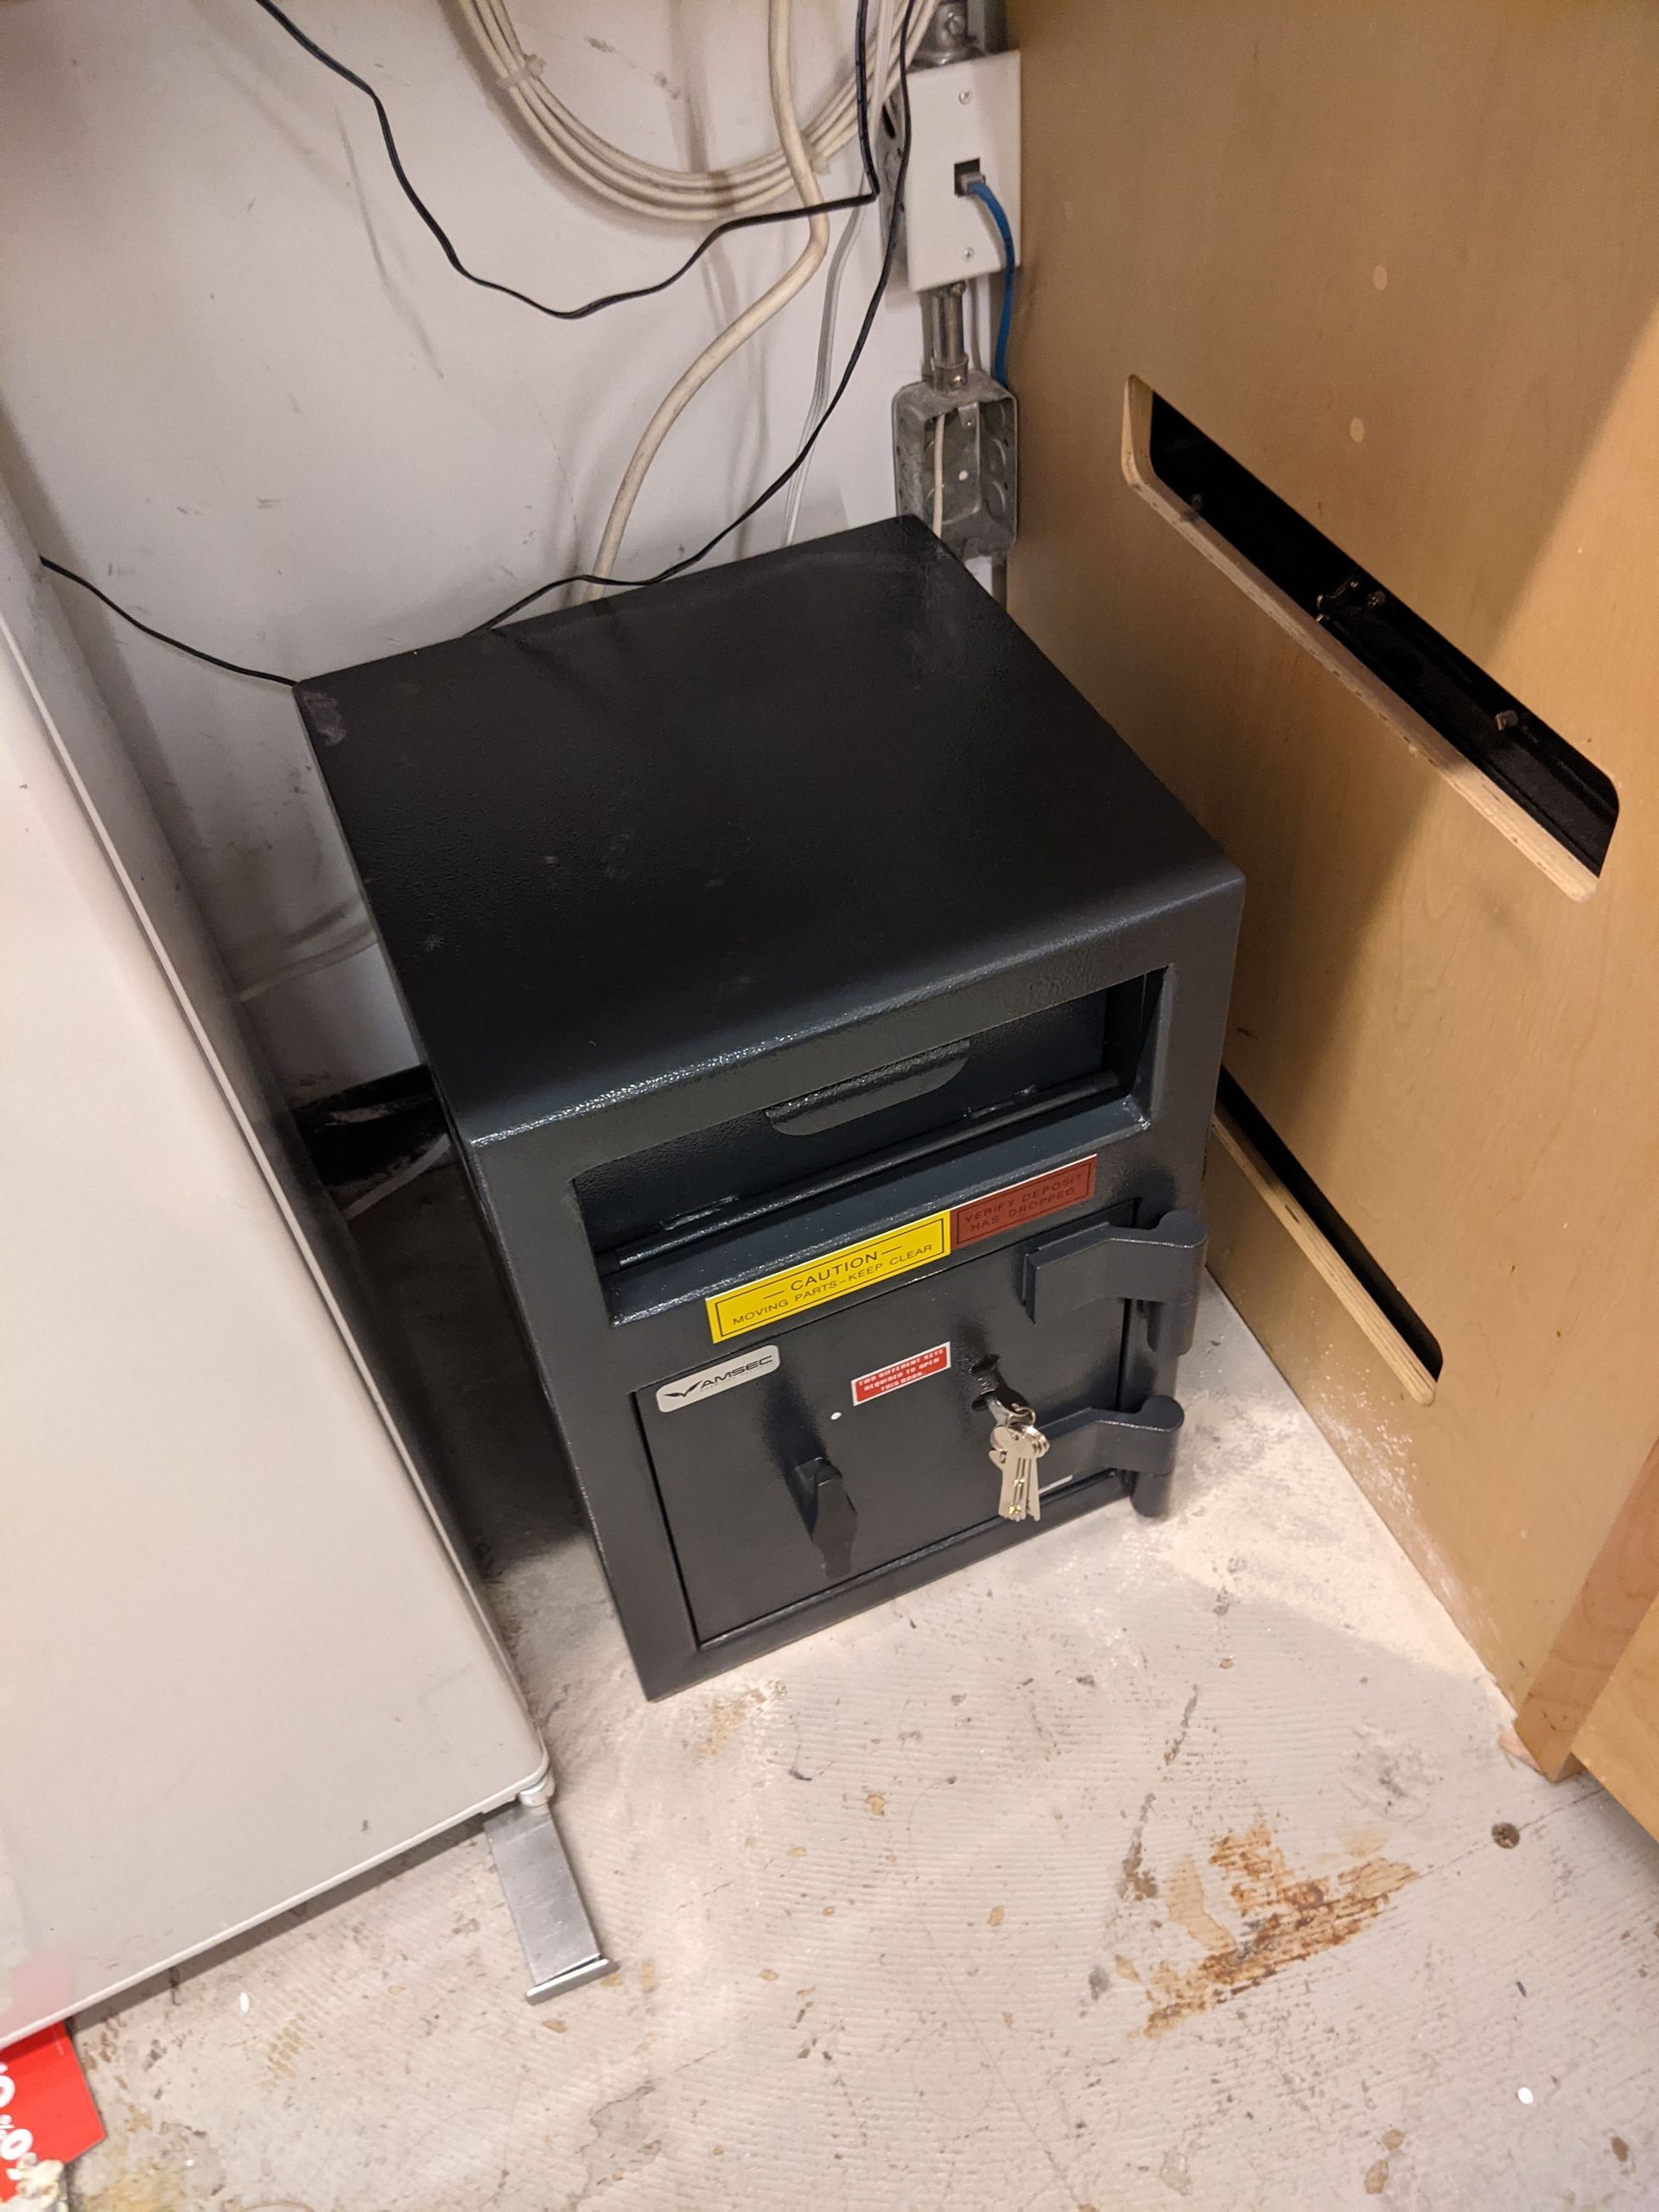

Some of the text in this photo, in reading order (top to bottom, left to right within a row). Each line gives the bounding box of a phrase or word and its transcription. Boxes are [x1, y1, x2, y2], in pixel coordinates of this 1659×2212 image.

[964, 1173, 1083, 1223] VERIFY DEPOSIT
[971, 1187, 1075, 1231] HAS DROPPED
[732, 1300, 789, 1325] MOVING
[889, 1243, 933, 1266] CLEAR
[790, 1251, 878, 1291] CAUTION
[701, 1355, 773, 1389] AMSEC
[906, 1366, 917, 1375] TO
